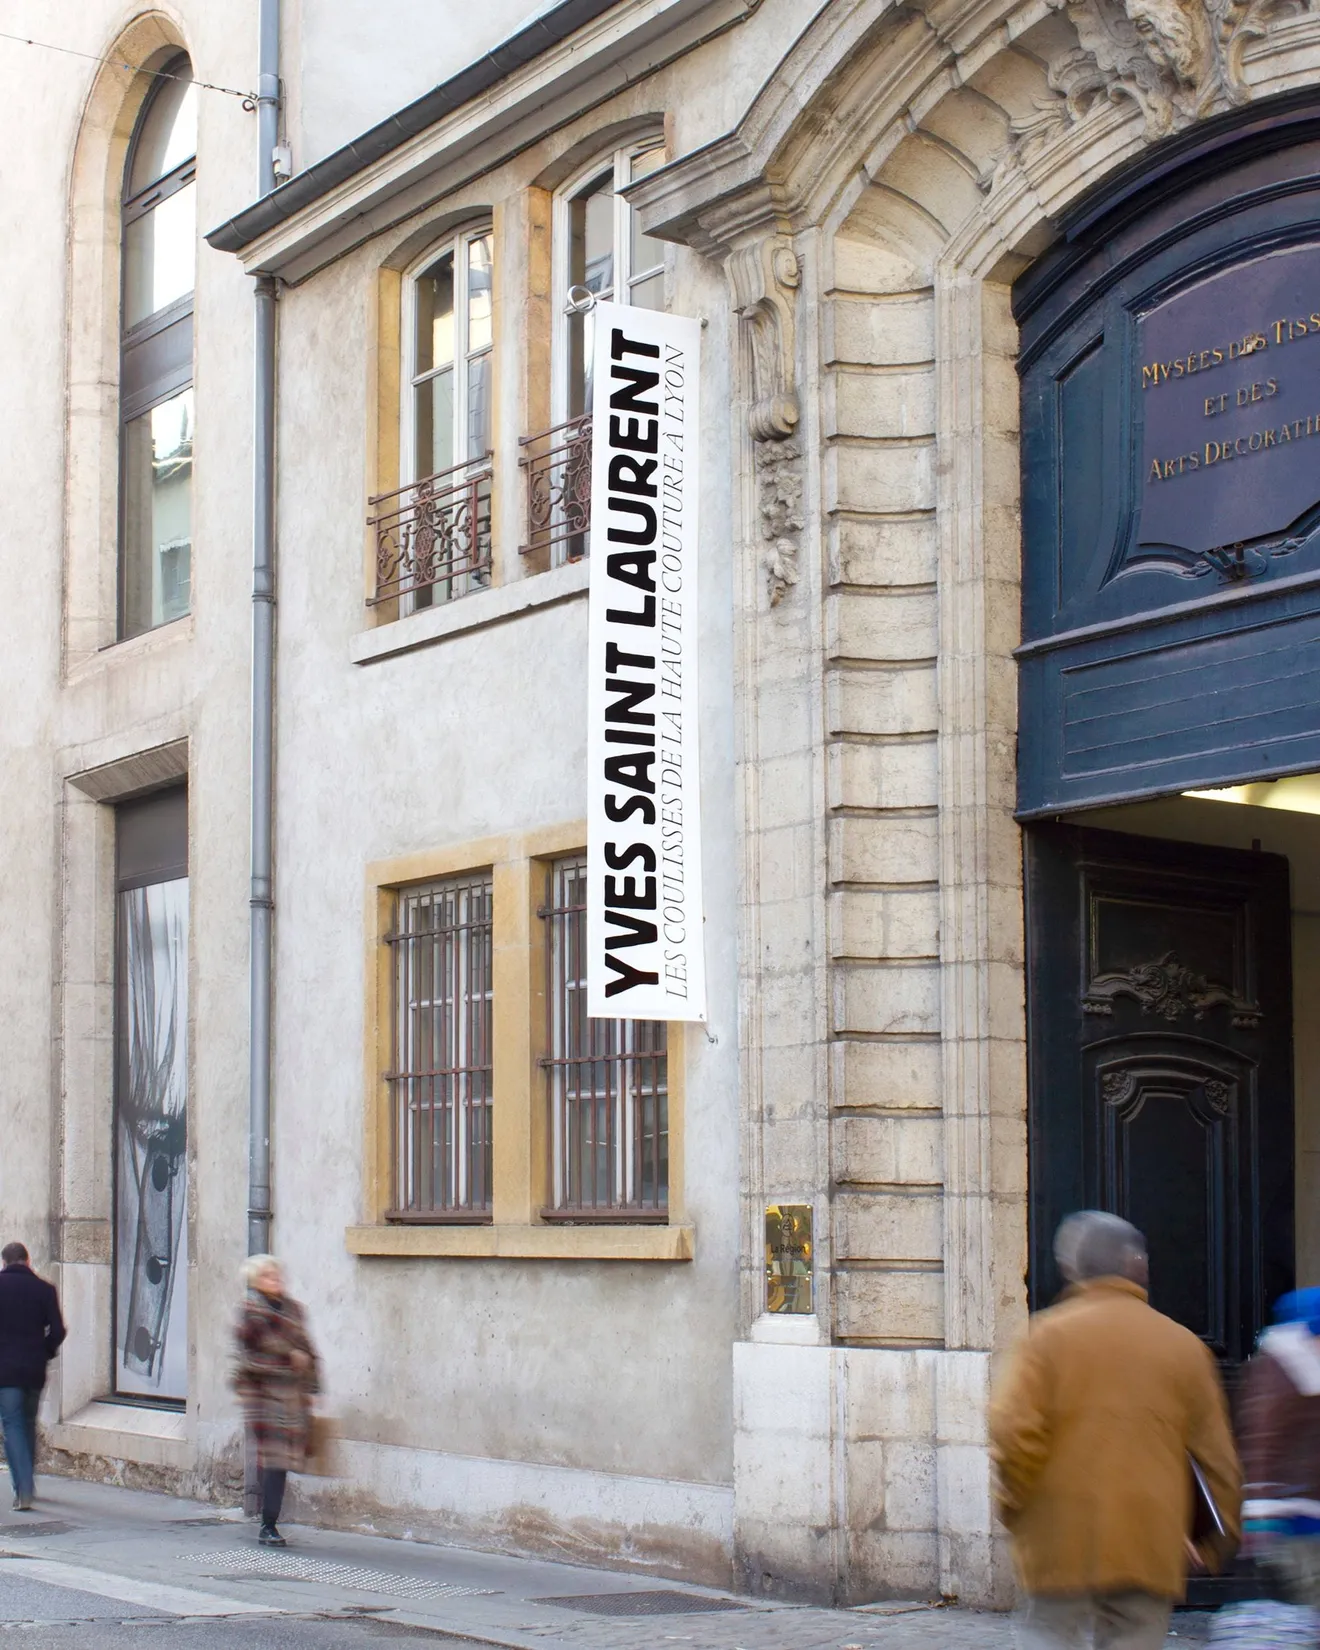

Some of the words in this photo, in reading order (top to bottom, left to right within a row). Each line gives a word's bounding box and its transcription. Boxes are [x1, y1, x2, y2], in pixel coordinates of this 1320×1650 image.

[664, 343, 686, 425] LYON
[1204, 394, 1228, 416] ET
[1236, 377, 1278, 407] DES
[605, 327, 660, 628] LAURENT
[661, 431, 684, 453] À
[1148, 450, 1200, 483] ARTS
[661, 454, 684, 593] COUTURE
[660, 597, 683, 702] HAUTE
[604, 641, 656, 825] SAINT
[661, 711, 683, 746] LA
[661, 749, 683, 791] DE
[661, 793, 687, 945] COULISSES
[604, 842, 660, 999] YVES
[663, 949, 688, 1001] LES
